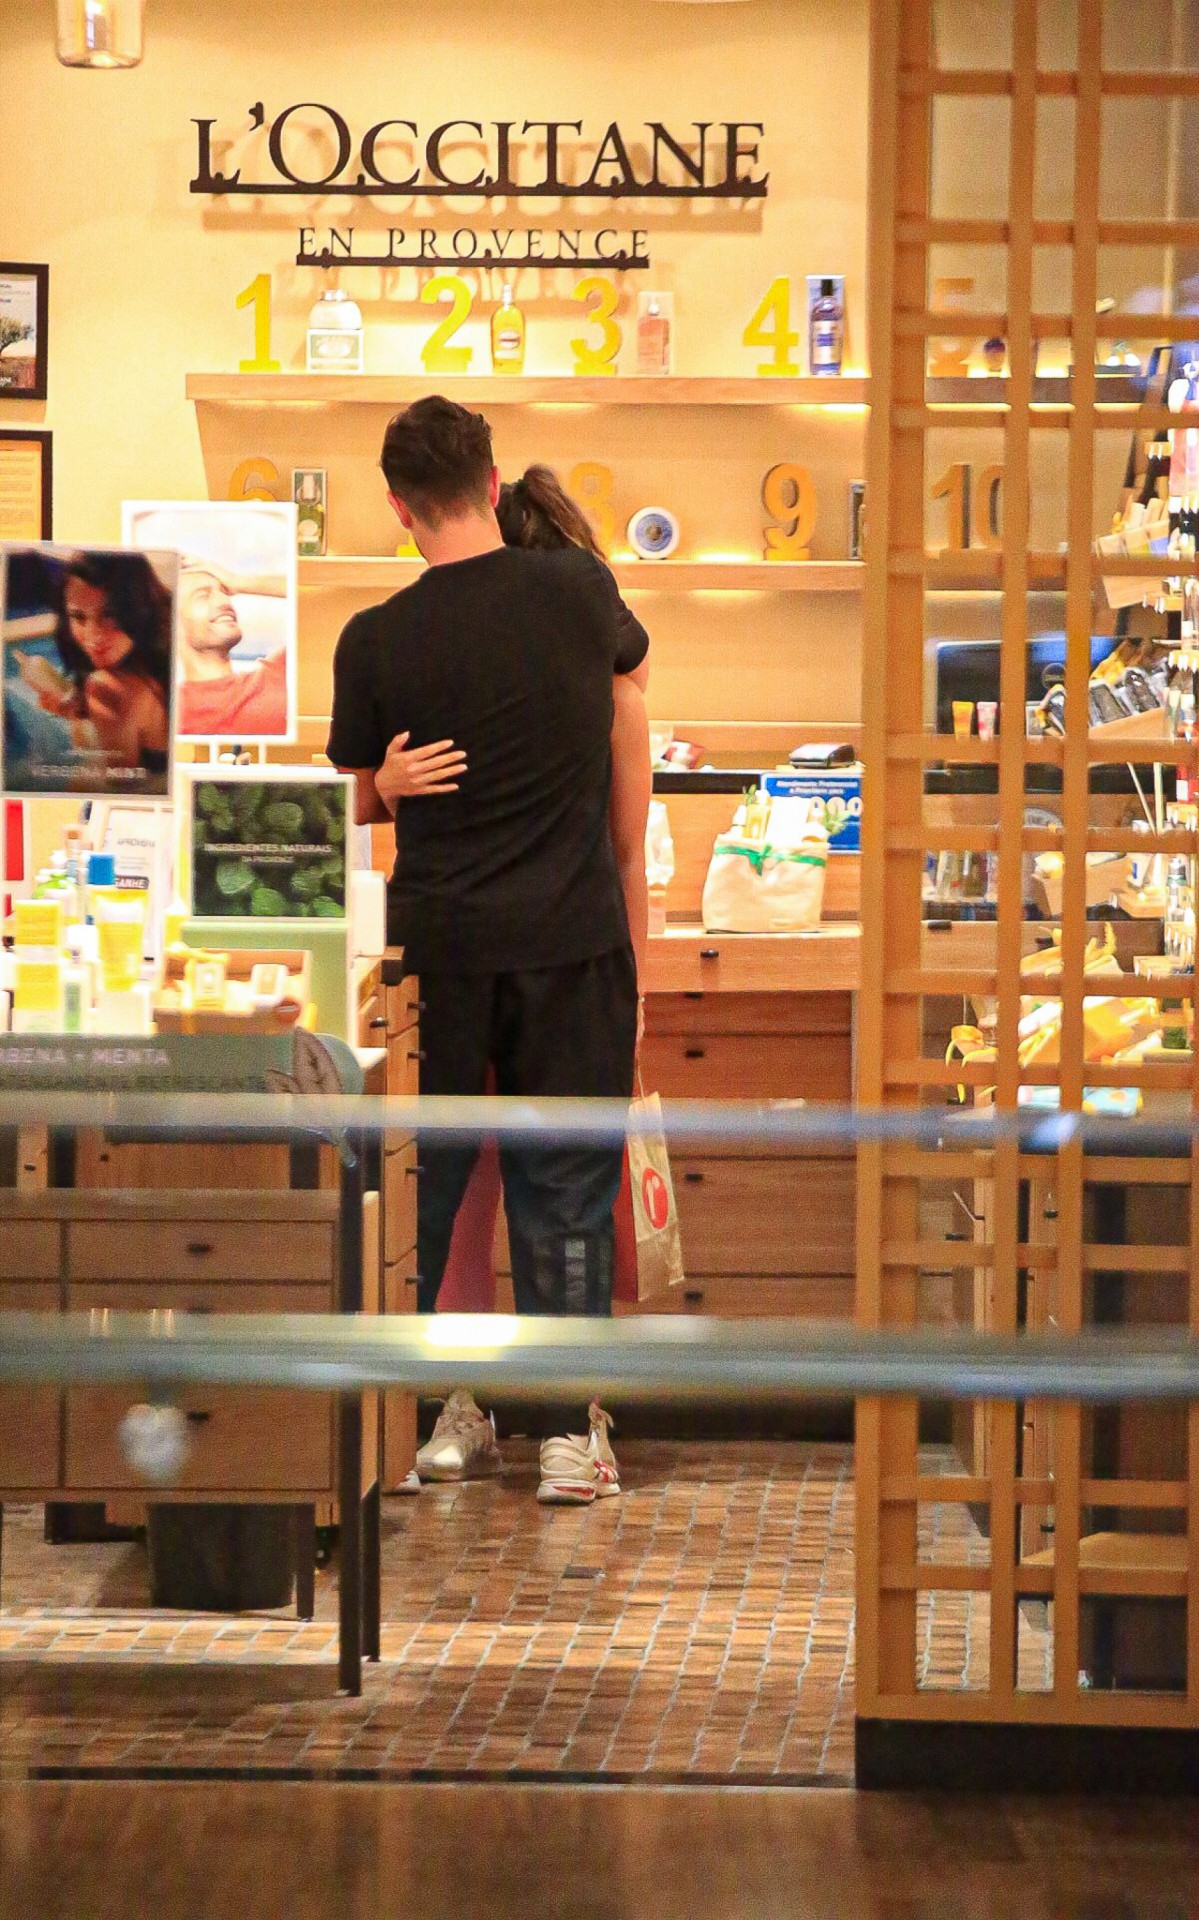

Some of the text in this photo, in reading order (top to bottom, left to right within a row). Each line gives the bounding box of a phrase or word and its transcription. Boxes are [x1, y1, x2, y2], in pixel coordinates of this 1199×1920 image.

[298, 227, 650, 262] EN PROVENCE
[235, 273, 281, 372] 1
[421, 276, 473, 373] 2
[570, 276, 621, 375] 3
[743, 274, 799, 376] 4
[761, 463, 815, 560] 9
